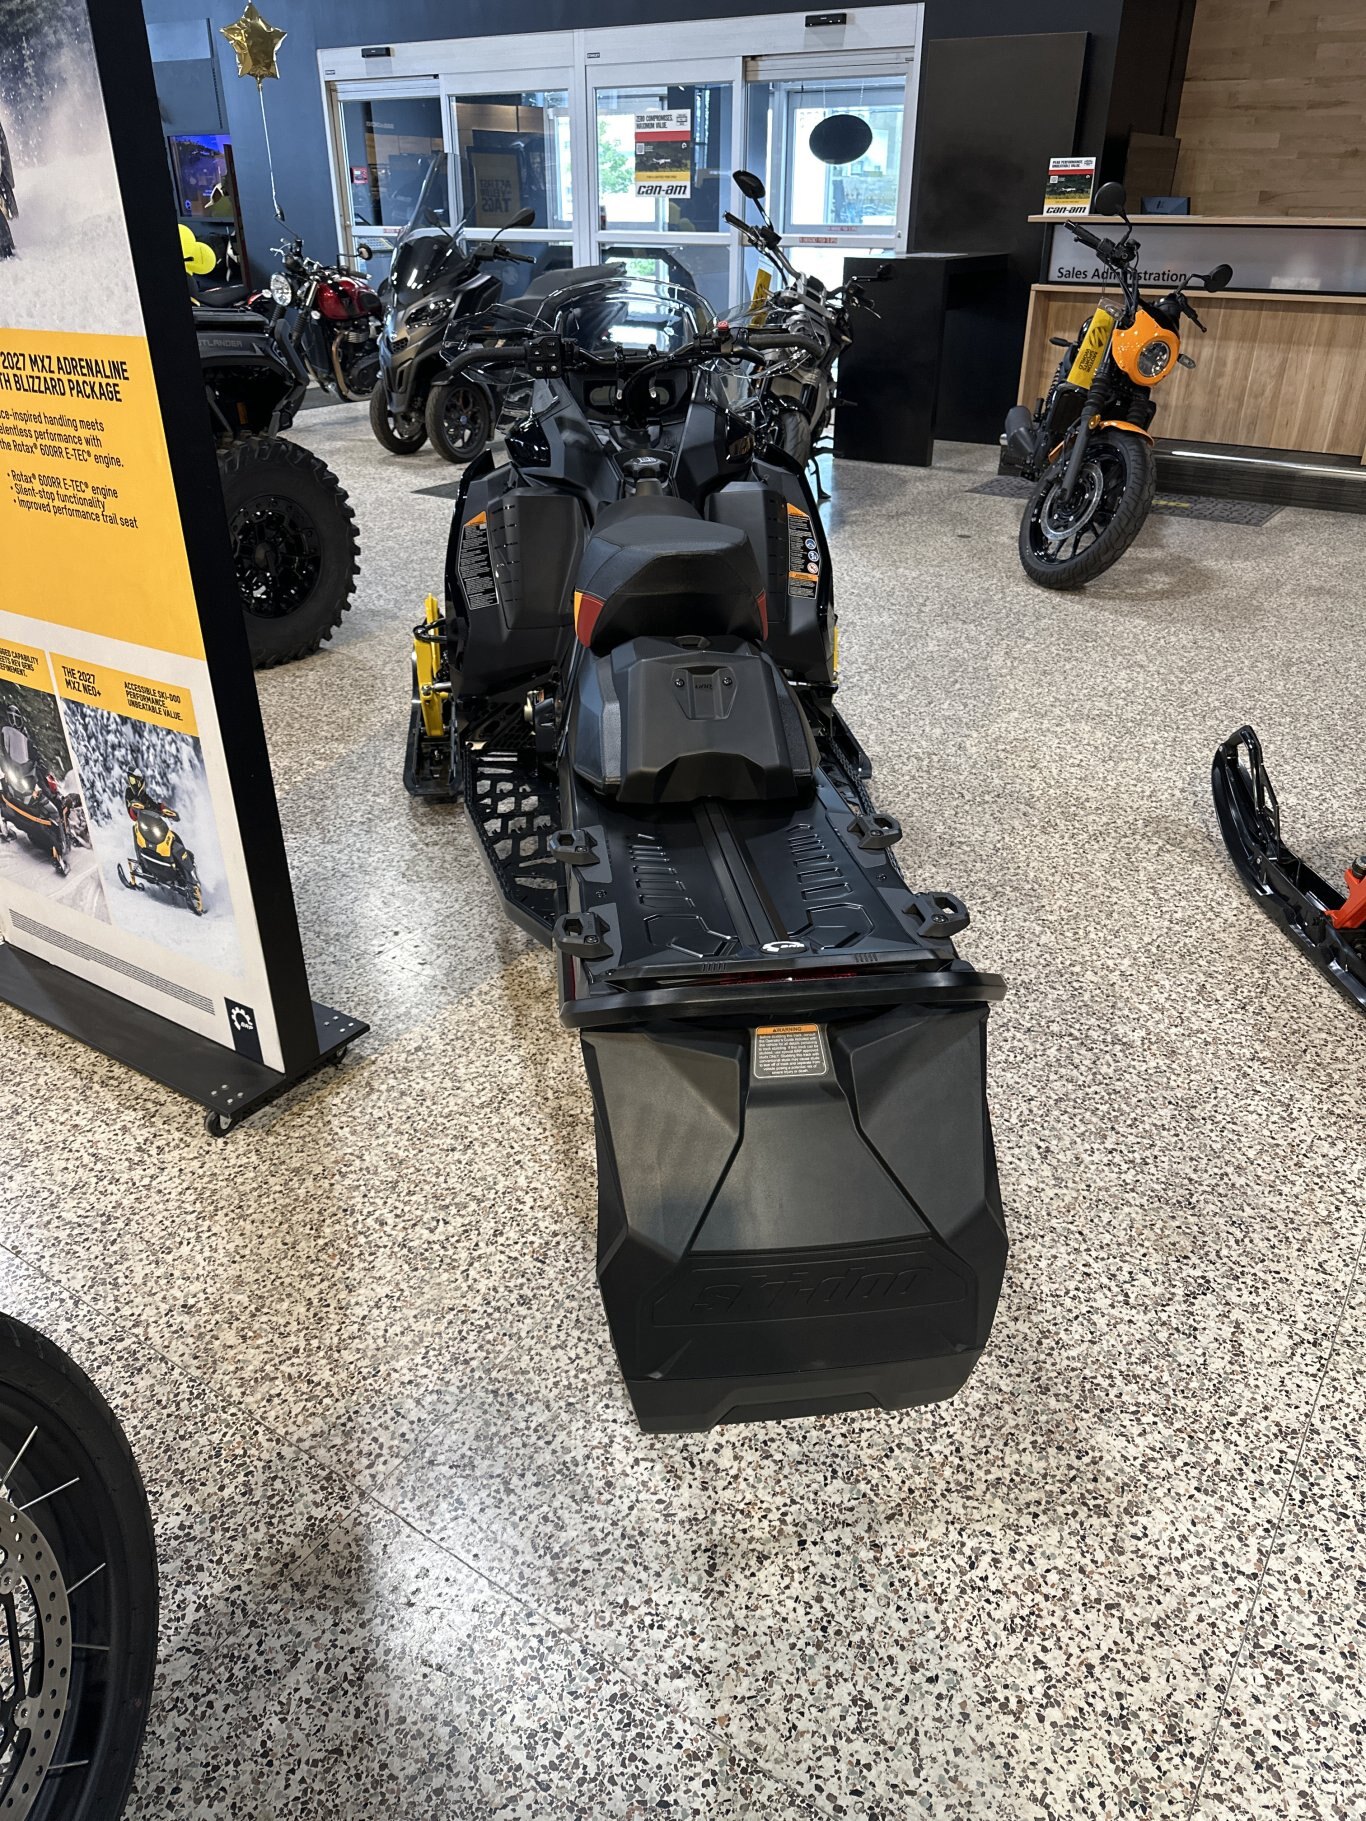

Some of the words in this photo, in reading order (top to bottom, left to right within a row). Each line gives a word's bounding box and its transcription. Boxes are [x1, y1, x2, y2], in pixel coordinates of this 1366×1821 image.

[637, 185, 688, 195] can-am
[1046, 206, 1087, 214] can-am
[1057, 267, 1088, 279] Sales
[1091, 267, 1187, 282] Admnstration
[0, 351, 25, 371] 2027
[28, 353, 55, 374] MXZ
[56, 356, 129, 381] ADRENALINE
[13, 373, 66, 397] BLIZZARD
[67, 378, 122, 402] PACKAGE
[43, 412, 78, 432] handling
[79, 418, 104, 432] meets
[34, 428, 82, 446] performance
[84, 434, 102, 449] with
[0, 438, 11, 450] the
[39, 442, 64, 459] 600RR
[94, 453, 124, 469] engine.
[38, 473, 62, 489] 600RR
[91, 484, 118, 499] engine
[14, 483, 55, 503] Silent-stop
[56, 490, 105, 512] functionality
[18, 496, 51, 514] Improved
[52, 504, 100, 522] performance
[101, 510, 119, 525] trail
[120, 516, 138, 529] seat
[11, 651, 39, 665] CAPABILITY
[62, 665, 76, 679] THE
[77, 670, 95, 685] 2027
[65, 678, 82, 692] MXZ
[82, 683, 101, 697] NEO+
[124, 681, 157, 697] ACCESSIBLE
[157, 690, 181, 703] SKI-DOO
[126, 690, 168, 708] PERFORMANCE.
[127, 699, 162, 716] UNBEATABLE
[163, 708, 183, 722] VALUE.
[690, 1267, 933, 1312] ski-doo
